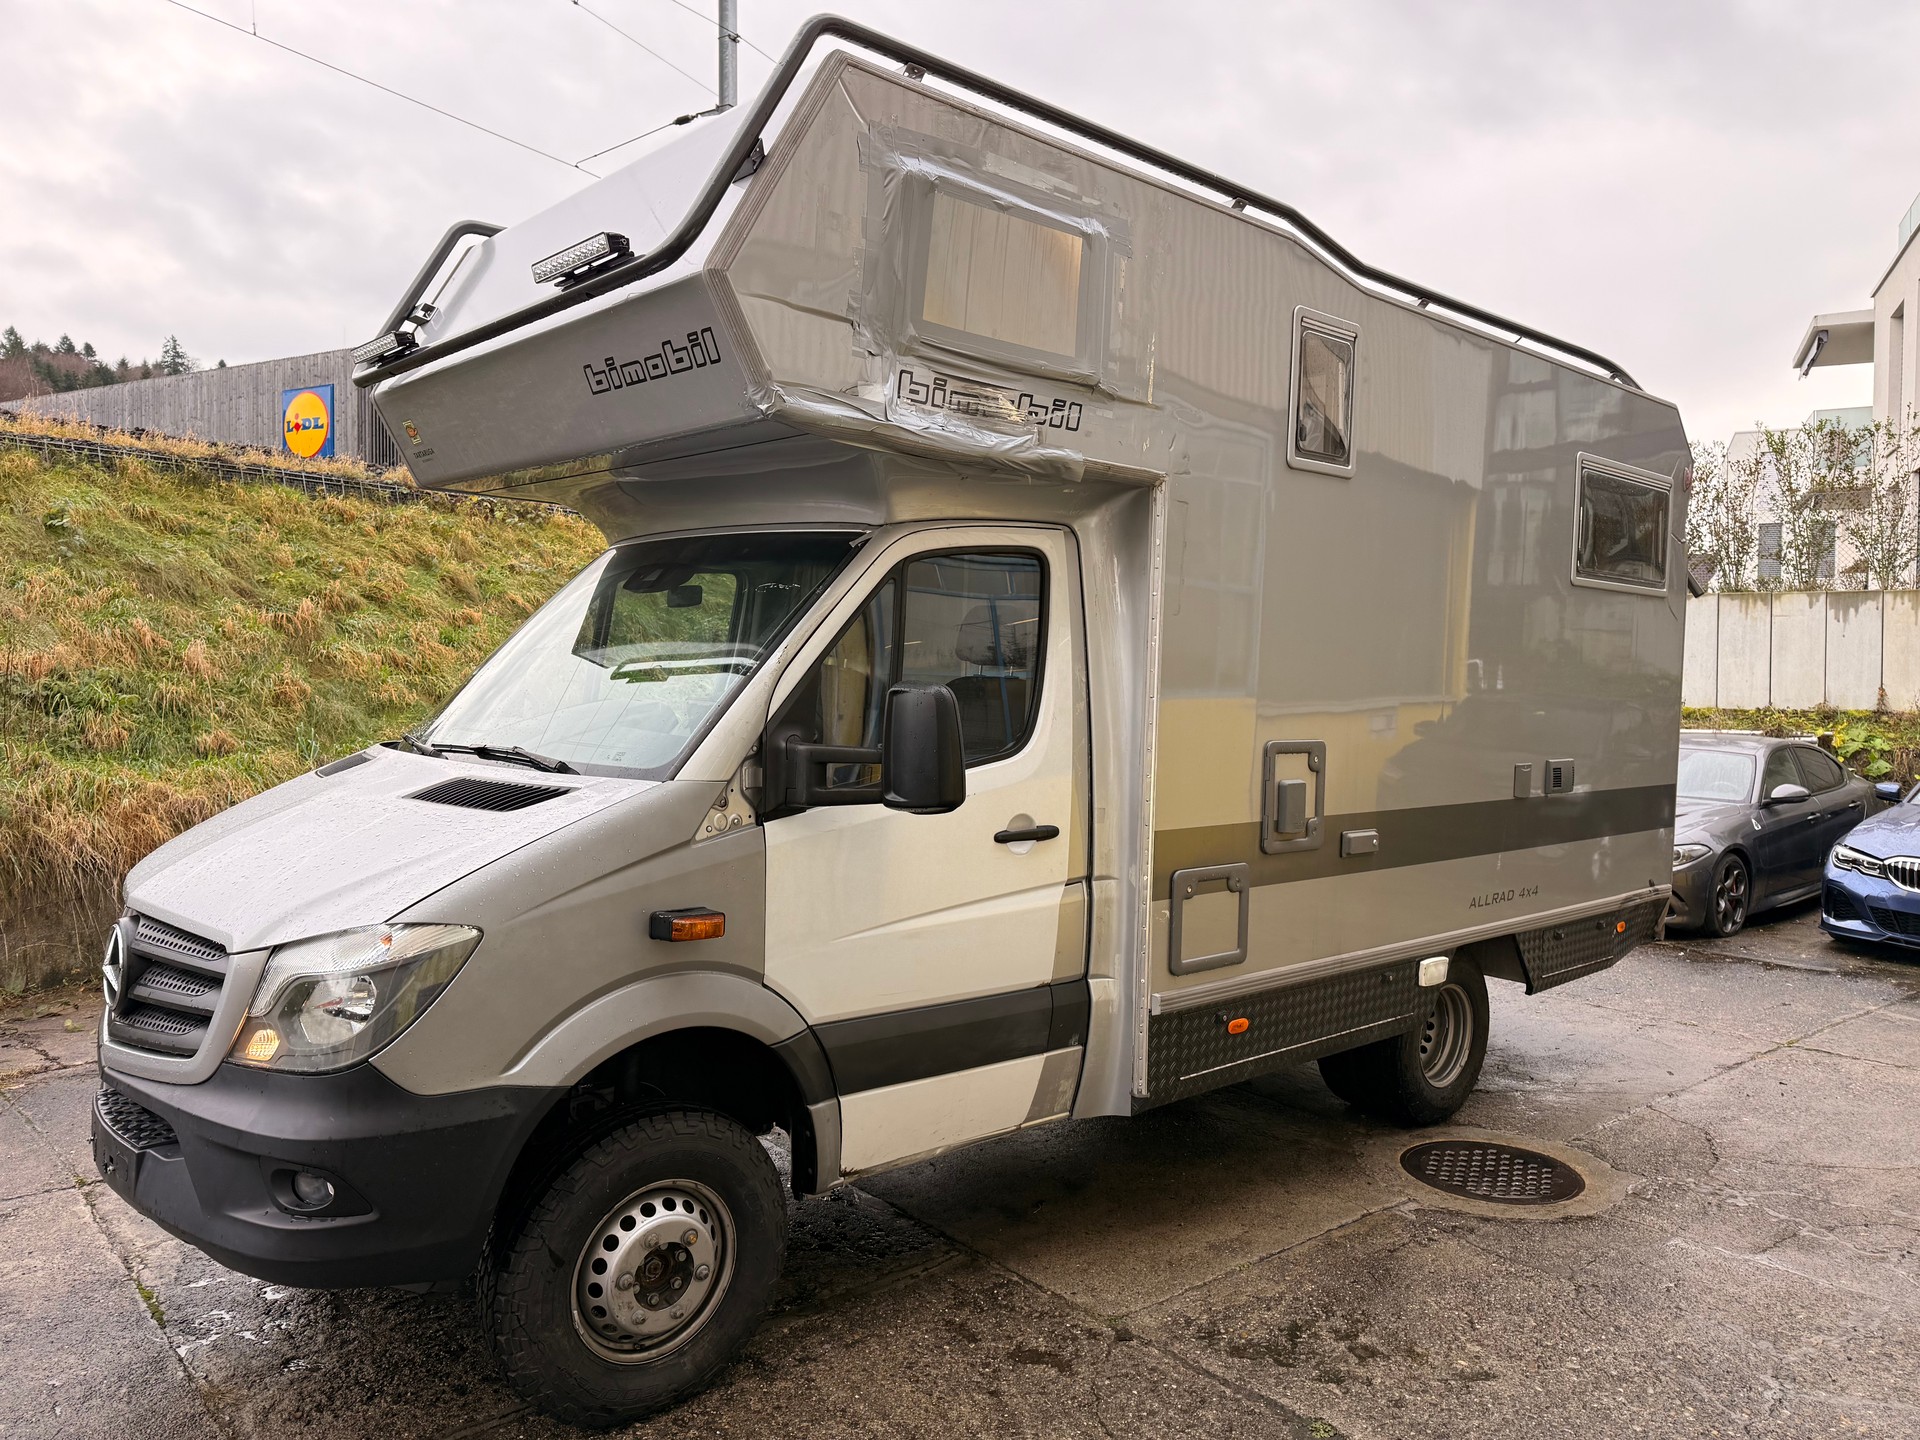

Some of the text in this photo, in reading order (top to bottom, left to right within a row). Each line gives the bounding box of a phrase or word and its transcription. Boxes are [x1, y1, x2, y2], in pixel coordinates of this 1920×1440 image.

[583, 326, 722, 396] bimobil
[898, 369, 1083, 432] bimbil
[1468, 884, 1539, 910] ALLRAD 4x4
